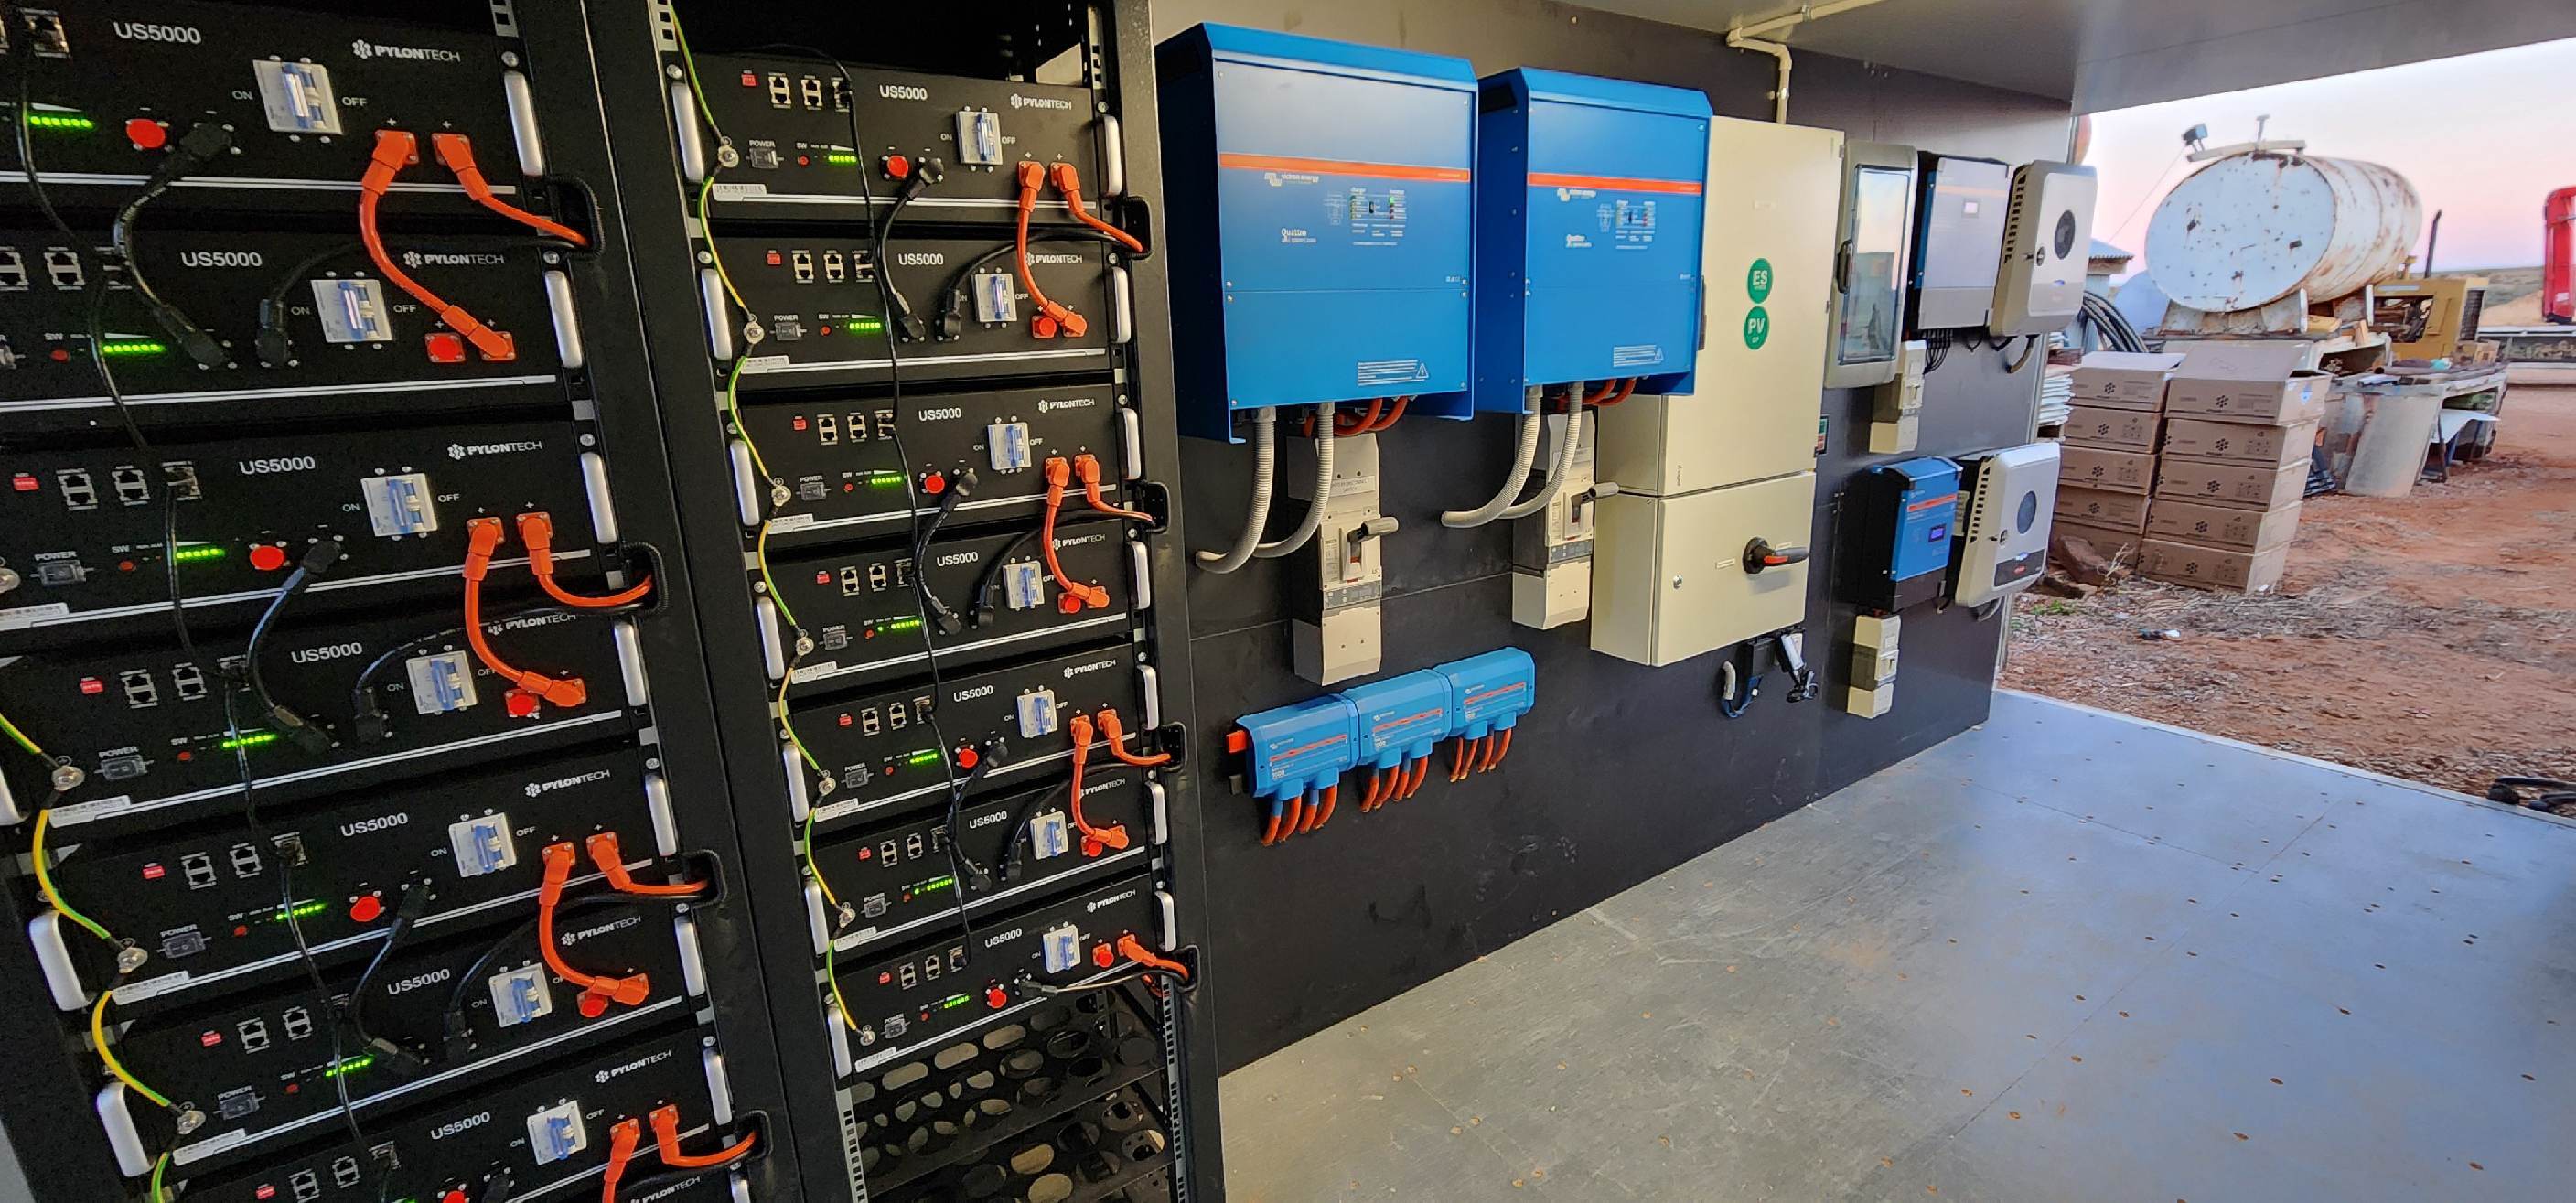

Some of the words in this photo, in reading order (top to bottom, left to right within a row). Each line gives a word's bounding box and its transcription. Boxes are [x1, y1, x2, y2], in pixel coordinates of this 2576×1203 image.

[113, 21, 201, 44] US5000
[374, 44, 460, 62] PYLONTECH
[231, 90, 253, 101] ON
[879, 85, 928, 101] US5000
[342, 96, 367, 107] OFF
[1023, 97, 1072, 110] PYLONTECH
[940, 133, 952, 141] ON
[1001, 136, 1016, 145] OFF
[749, 140, 776, 148] POWER
[1281, 228, 1307, 240] Quattro
[181, 252, 263, 267] US5000
[424, 254, 504, 265] PYLONTECH
[898, 253, 944, 265] US5000
[1036, 254, 1082, 264] PYLONTECH
[1752, 270, 1768, 286] ES
[1015, 293, 1029, 301] OFF
[290, 306, 310, 316] ON
[393, 304, 417, 314] OFF
[1747, 317, 1766, 335] PV
[44, 332, 63, 340] SW
[1049, 398, 1095, 409] PYLONTECH
[918, 407, 962, 422] US5000
[1029, 437, 1044, 446] OFF
[467, 440, 542, 455] PYLONTECH
[239, 456, 316, 476] US5000
[800, 475, 823, 483] POWER
[437, 493, 460, 503] OFF
[342, 503, 360, 514] ON
[1062, 533, 1106, 547] PYLONTECH
[112, 545, 130, 553] SW
[34, 551, 77, 562] POWER
[936, 551, 979, 567] US5000
[506, 613, 576, 630] PYLONTECH
[822, 624, 845, 633] POWER
[291, 642, 363, 663] US5000
[1073, 659, 1117, 675] PYLONTECH
[387, 683, 404, 693] ON
[953, 685, 994, 702] US5000
[1056, 701, 1068, 710] OFF
[171, 737, 188, 746] SW
[99, 747, 139, 758] POWER
[844, 763, 866, 772] POWER
[542, 769, 611, 791] PYLONTECH
[1085, 778, 1126, 797] PYLONTECH
[340, 812, 409, 837] US5000
[969, 811, 1008, 830] US5000
[516, 827, 536, 837] OFF
[430, 847, 447, 857] ON
[864, 892, 886, 903] POWER
[1097, 888, 1136, 909] PYLONTECH
[228, 913, 243, 921] SW
[159, 924, 198, 938] POWER
[576, 916, 641, 941] PYLONTECH
[984, 928, 1023, 949] US5000
[1079, 932, 1091, 942] OFF
[1031, 951, 1042, 960] ON
[387, 968, 450, 995] US5000
[470, 998, 488, 1008] ON
[884, 1013, 905, 1025] POWER
[610, 1049, 672, 1078] PYLONTECH
[280, 1072, 295, 1081] SW
[217, 1086, 252, 1101] POWER
[585, 1108, 605, 1120] OFF
[430, 1112, 491, 1141] US5000
[510, 1138, 525, 1148] ON
[642, 1176, 701, 1203] PYLONTECH
